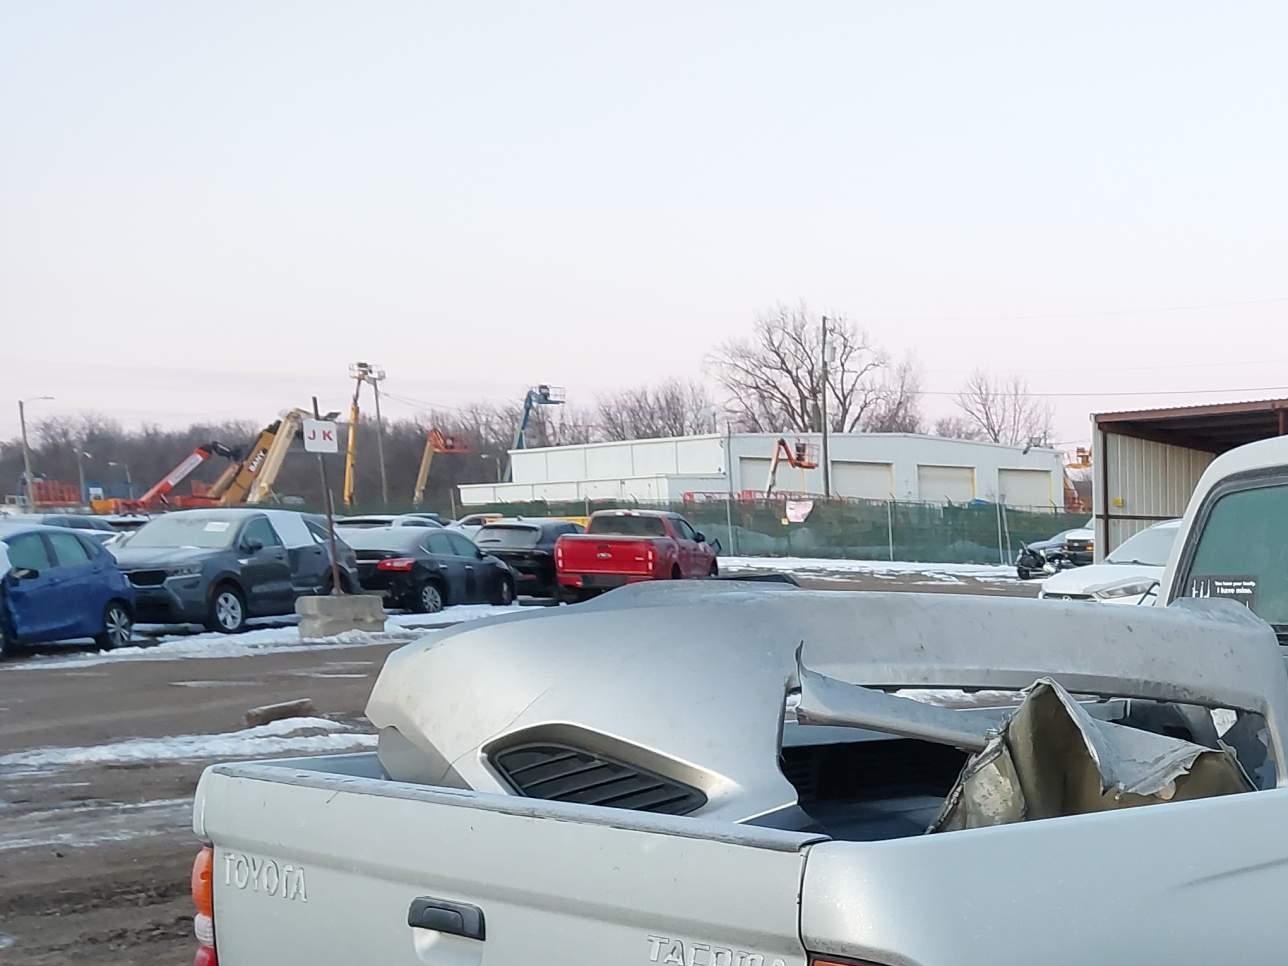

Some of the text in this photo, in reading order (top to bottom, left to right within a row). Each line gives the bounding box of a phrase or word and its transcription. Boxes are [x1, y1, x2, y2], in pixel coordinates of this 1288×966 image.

[307, 429, 333, 441] J K
[224, 852, 308, 903] TOYOTA
